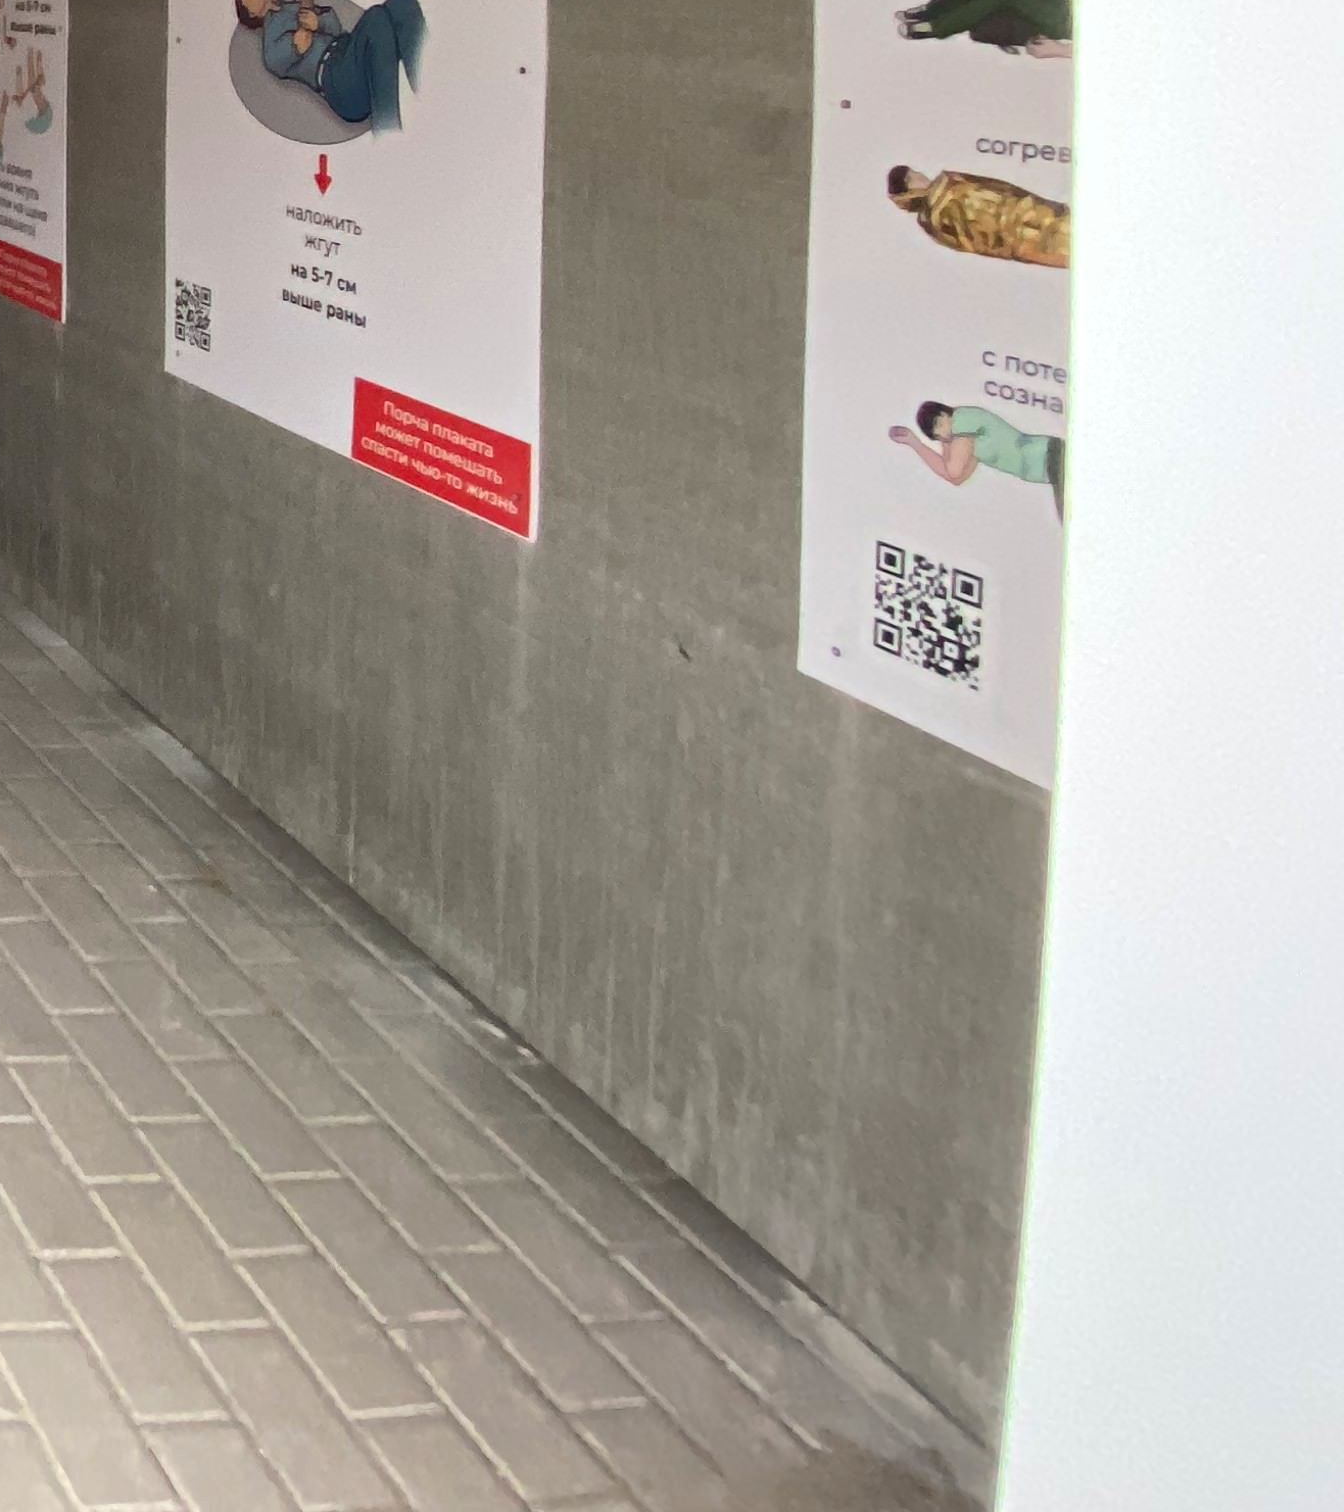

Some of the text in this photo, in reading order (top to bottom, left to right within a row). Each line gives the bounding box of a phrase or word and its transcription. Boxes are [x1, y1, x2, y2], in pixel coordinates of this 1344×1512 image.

[286, 204, 363, 236] наложить
[305, 235, 341, 257] жгут
[291, 263, 357, 294] на 5-7 см
[281, 288, 367, 328] выше раны
[982, 351, 1067, 384] с поте
[983, 380, 1064, 414] созна
[384, 400, 494, 458] Порча плаката
[376, 421, 503, 485] может помешать
[361, 436, 518, 515] спасти чью-то жизнь
